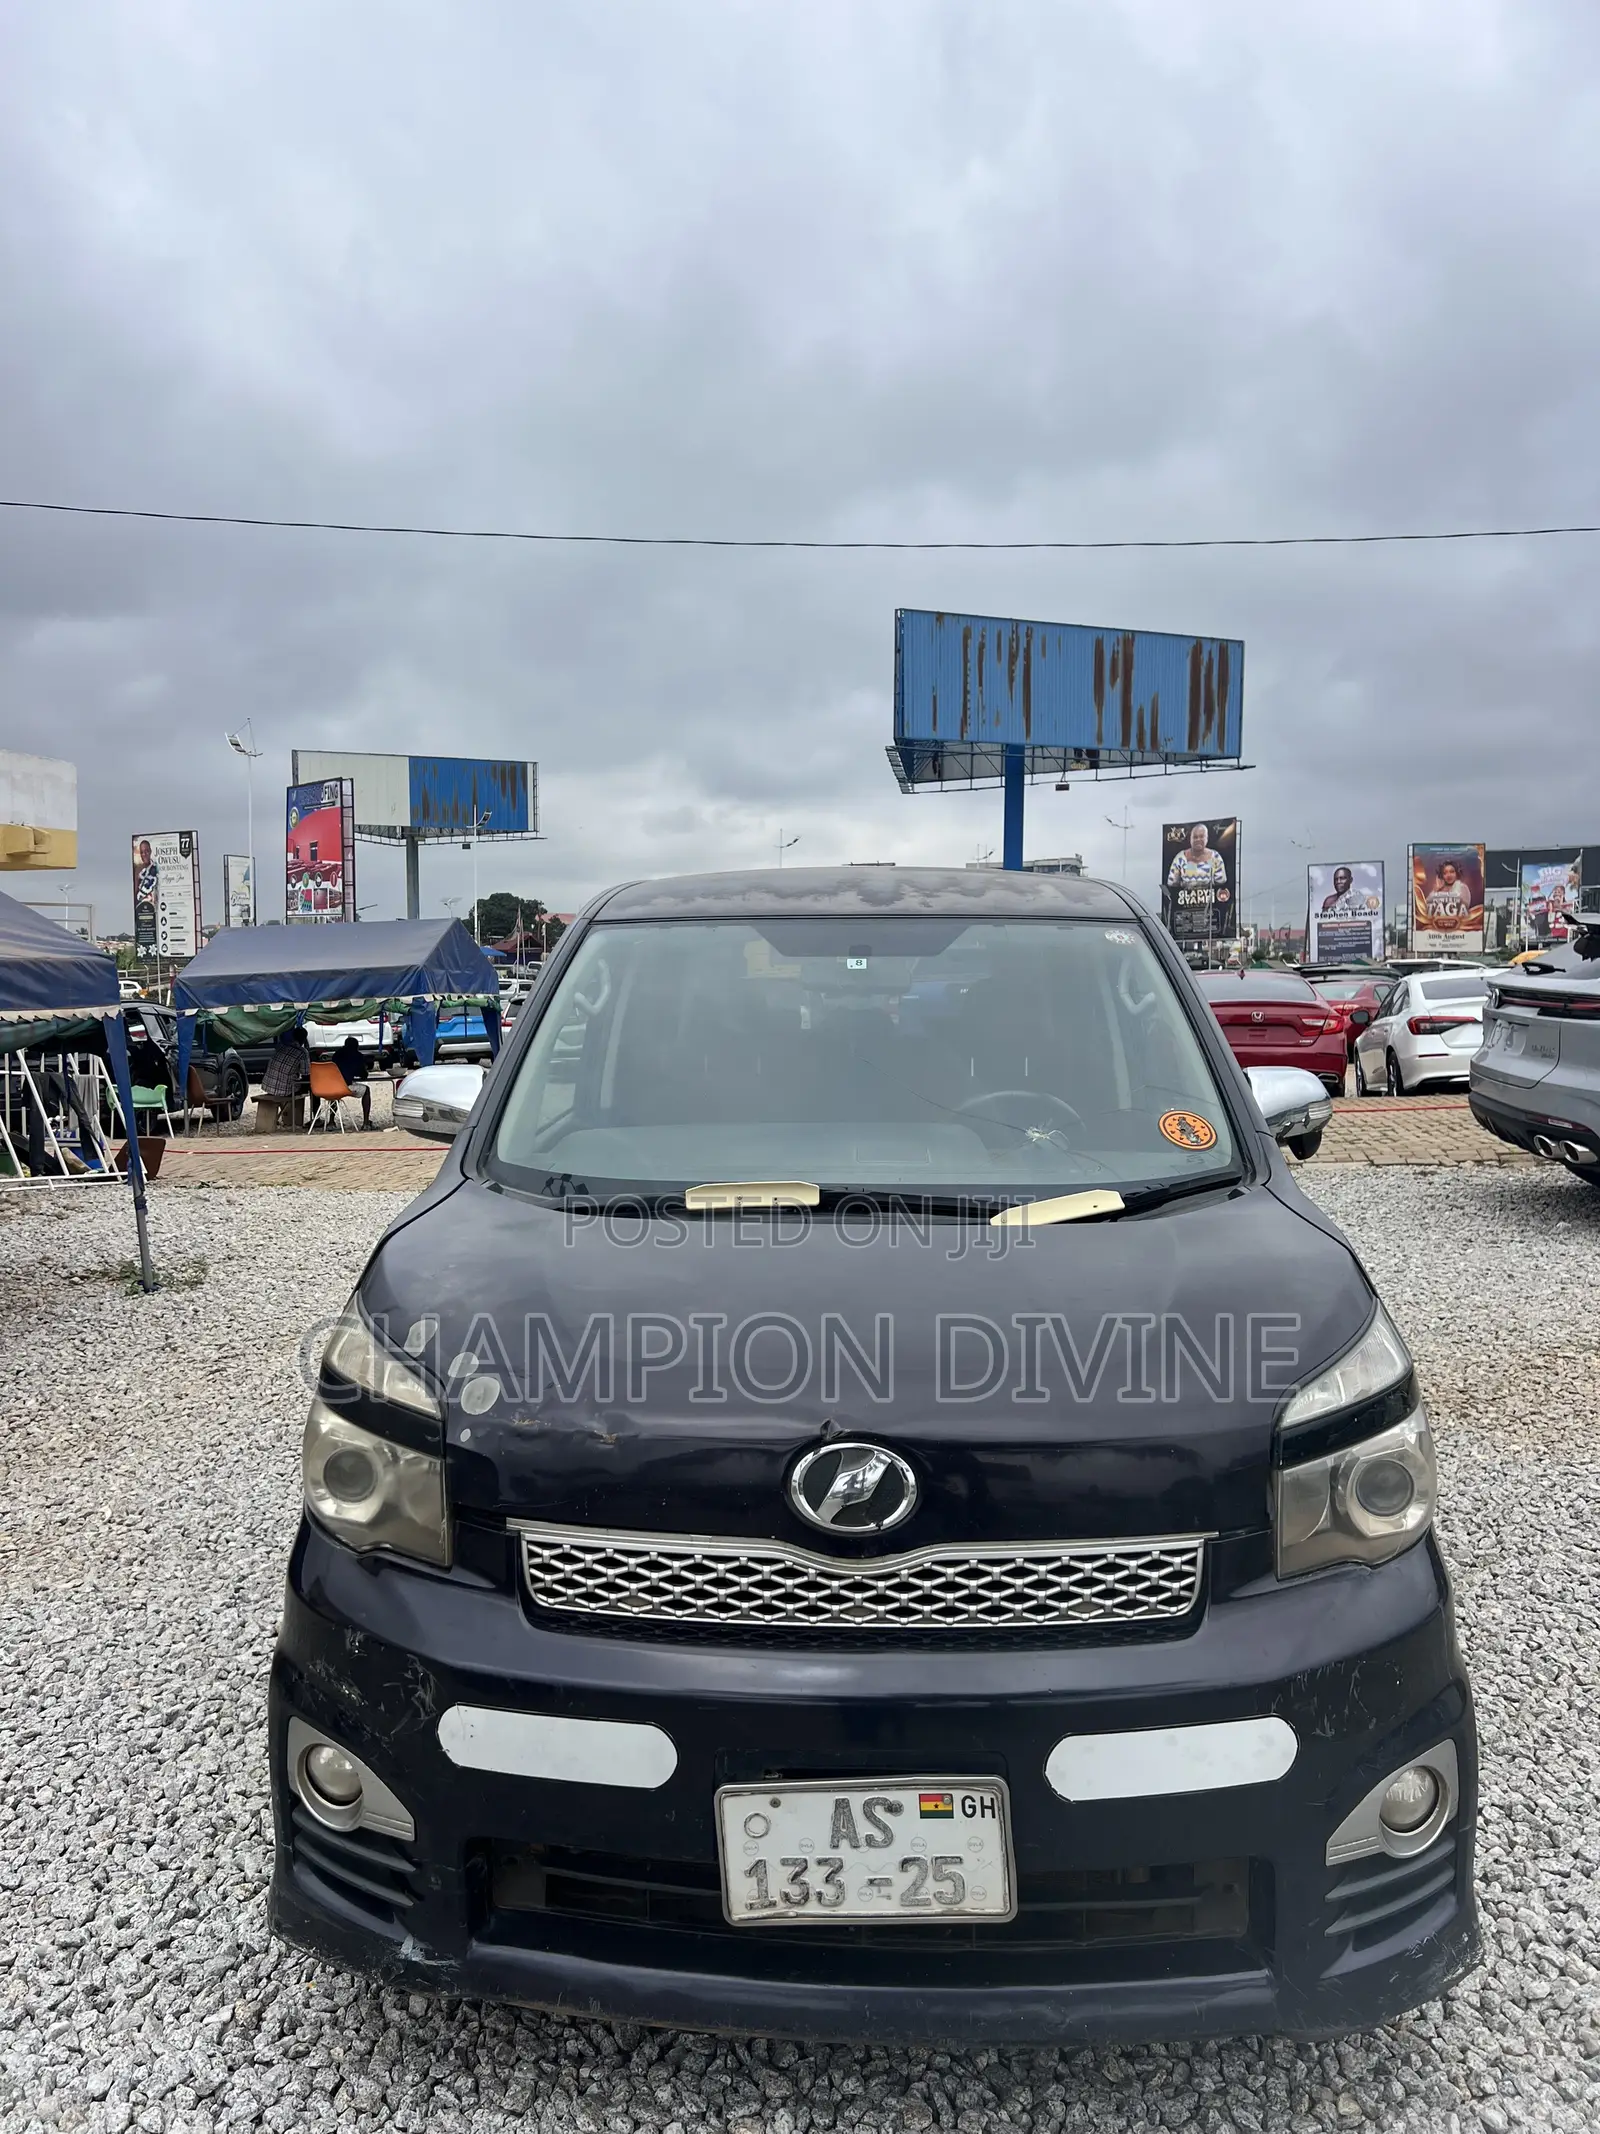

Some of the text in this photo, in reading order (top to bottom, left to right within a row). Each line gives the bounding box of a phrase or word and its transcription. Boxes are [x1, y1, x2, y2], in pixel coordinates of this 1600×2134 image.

[181, 838, 190, 848] 77
[154, 846, 178, 857] JOSEPH
[158, 856, 181, 865] OWUSU
[1314, 911, 1349, 919] Stephen
[1427, 903, 1468, 918] TAGA
[960, 1795, 997, 1819] GH
[829, 1796, 896, 1849] AS
